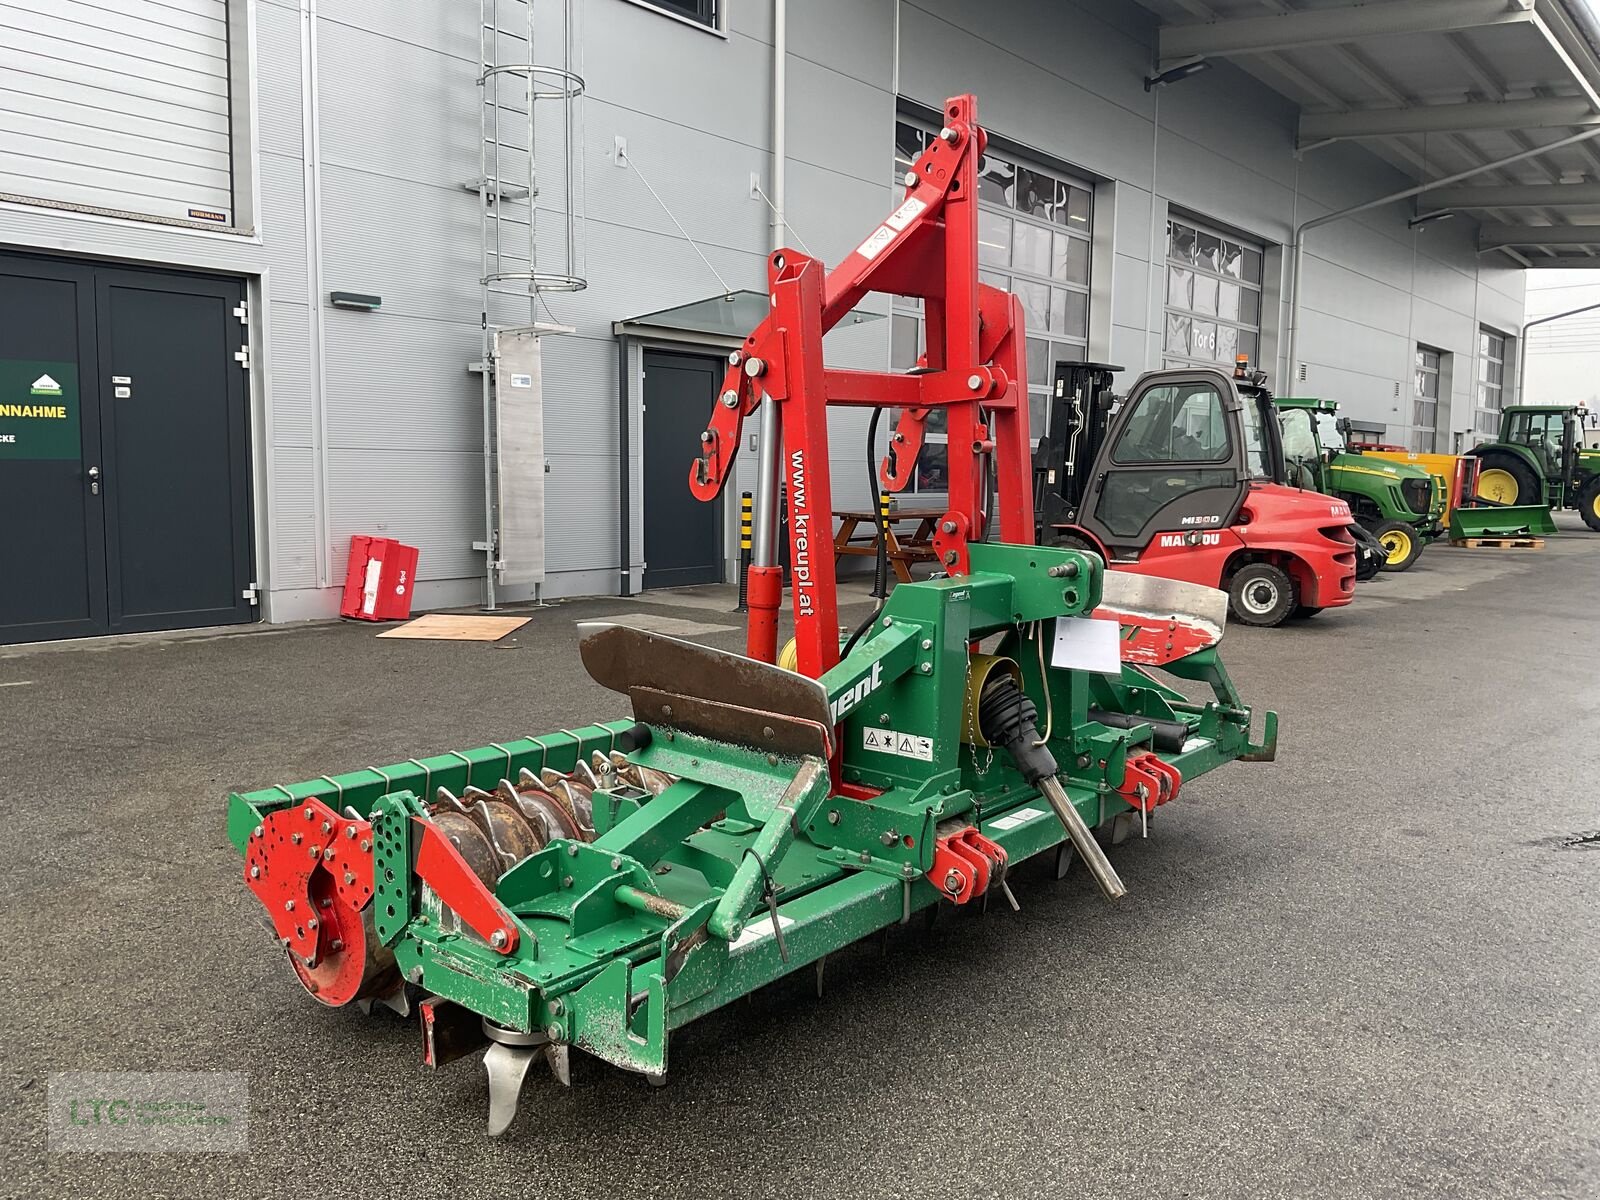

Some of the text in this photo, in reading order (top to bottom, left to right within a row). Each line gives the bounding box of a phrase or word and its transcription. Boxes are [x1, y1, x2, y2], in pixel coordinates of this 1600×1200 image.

[1193, 329, 1216, 350] Tor 6
[791, 450, 814, 617] www.kreupl.at
[1160, 533, 1220, 547] MAIOU
